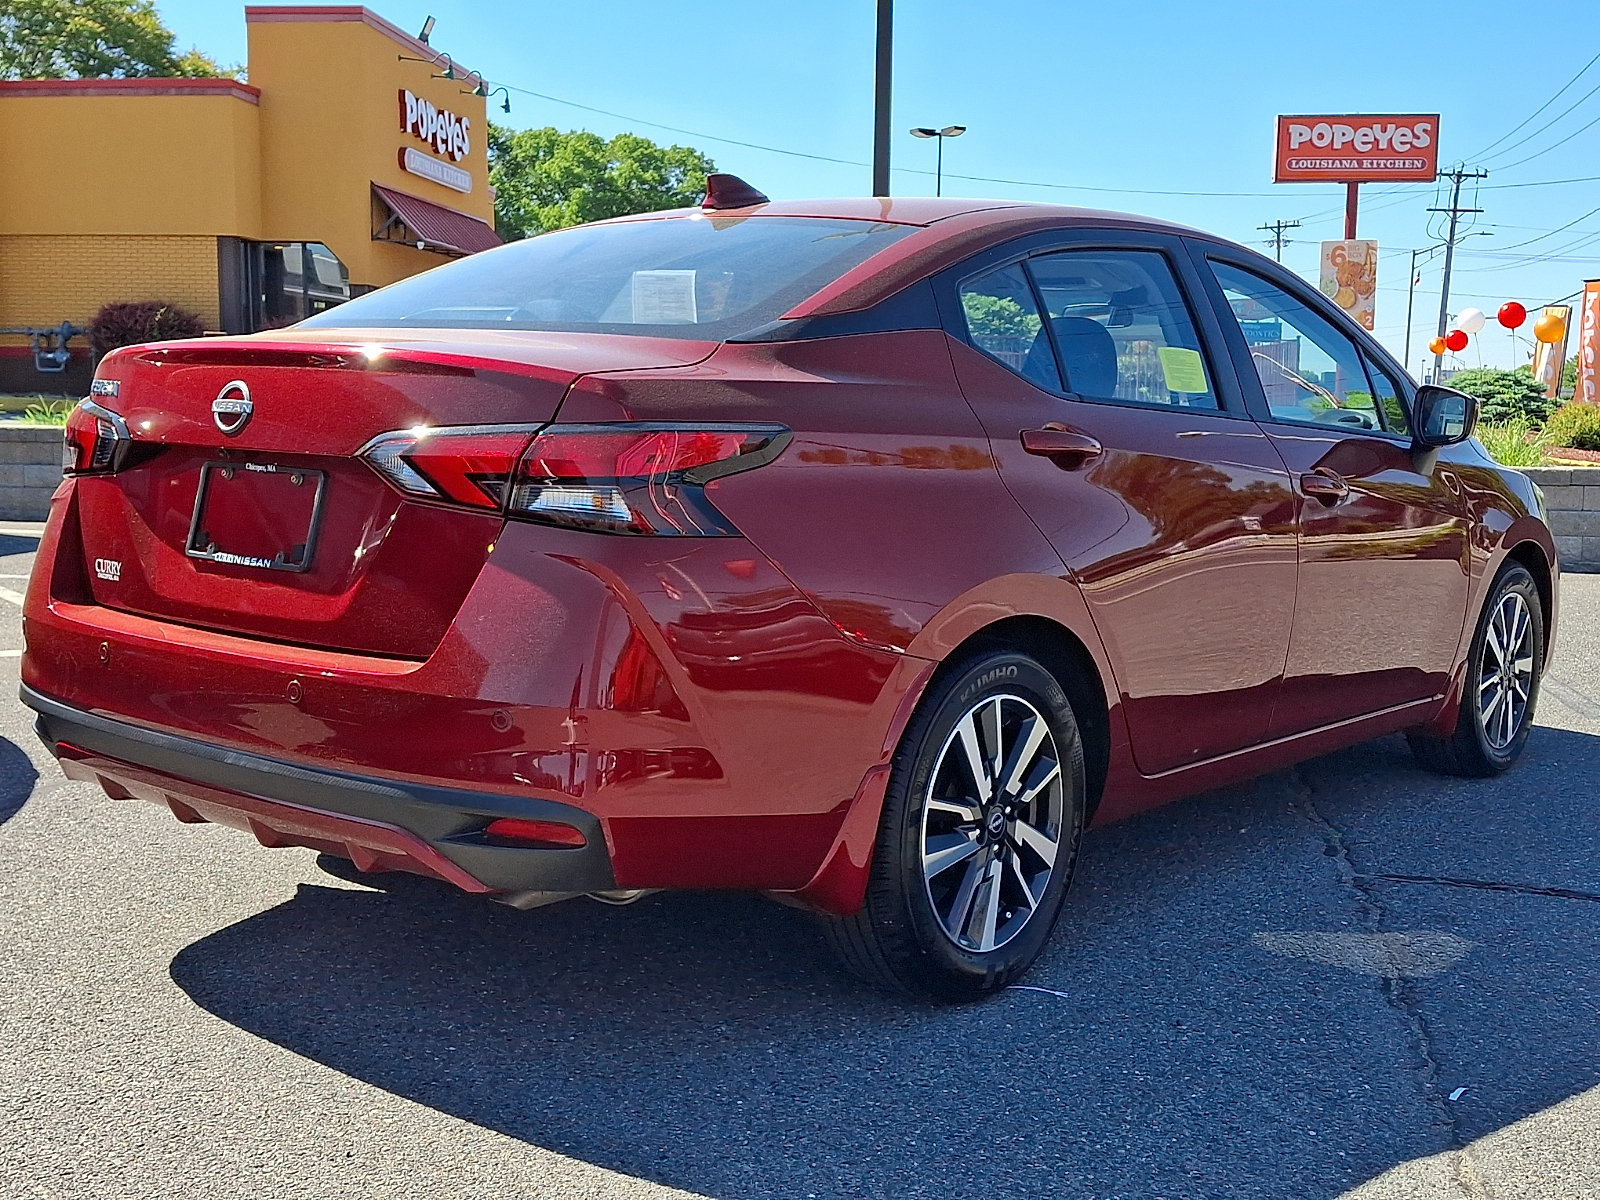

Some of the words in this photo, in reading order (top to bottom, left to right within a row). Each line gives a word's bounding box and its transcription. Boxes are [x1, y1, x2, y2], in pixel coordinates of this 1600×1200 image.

[1289, 122, 1432, 152] POPeYeS
[1291, 159, 1359, 169] LOUISIANA
[1362, 159, 1423, 169] KITCHEN
[213, 400, 252, 414] NISSAN
[95, 558, 122, 576] CURRY
[234, 555, 272, 568] NISSAN
[960, 665, 1018, 703] KUMHO
